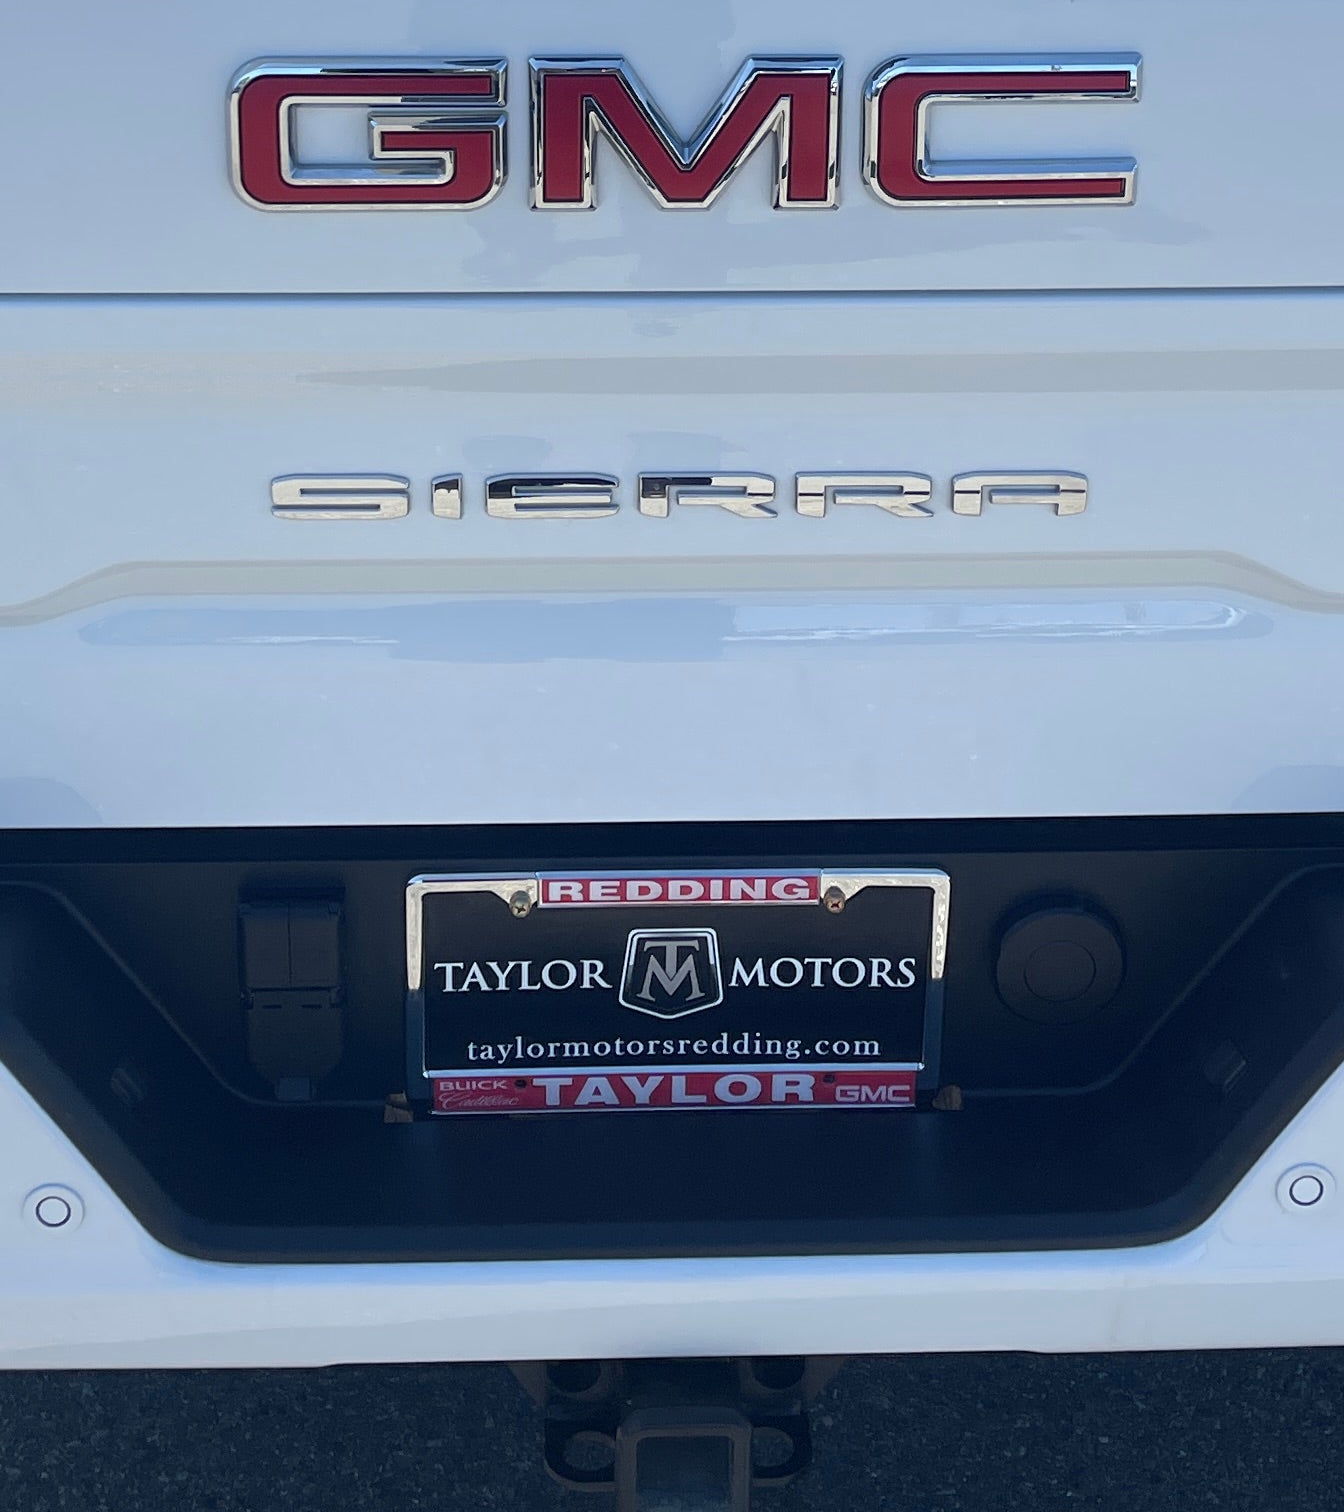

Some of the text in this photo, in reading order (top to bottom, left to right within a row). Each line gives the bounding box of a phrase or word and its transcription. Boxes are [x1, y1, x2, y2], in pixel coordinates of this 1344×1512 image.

[226, 52, 1142, 212] GMC
[269, 470, 1089, 521] SIERRA
[547, 877, 813, 903] REDDING
[433, 956, 917, 993] TAYLOR MOTORS
[466, 1032, 881, 1065] taylormotorsredding.com
[439, 1073, 912, 1107] BUICK TAYLOR GMC
